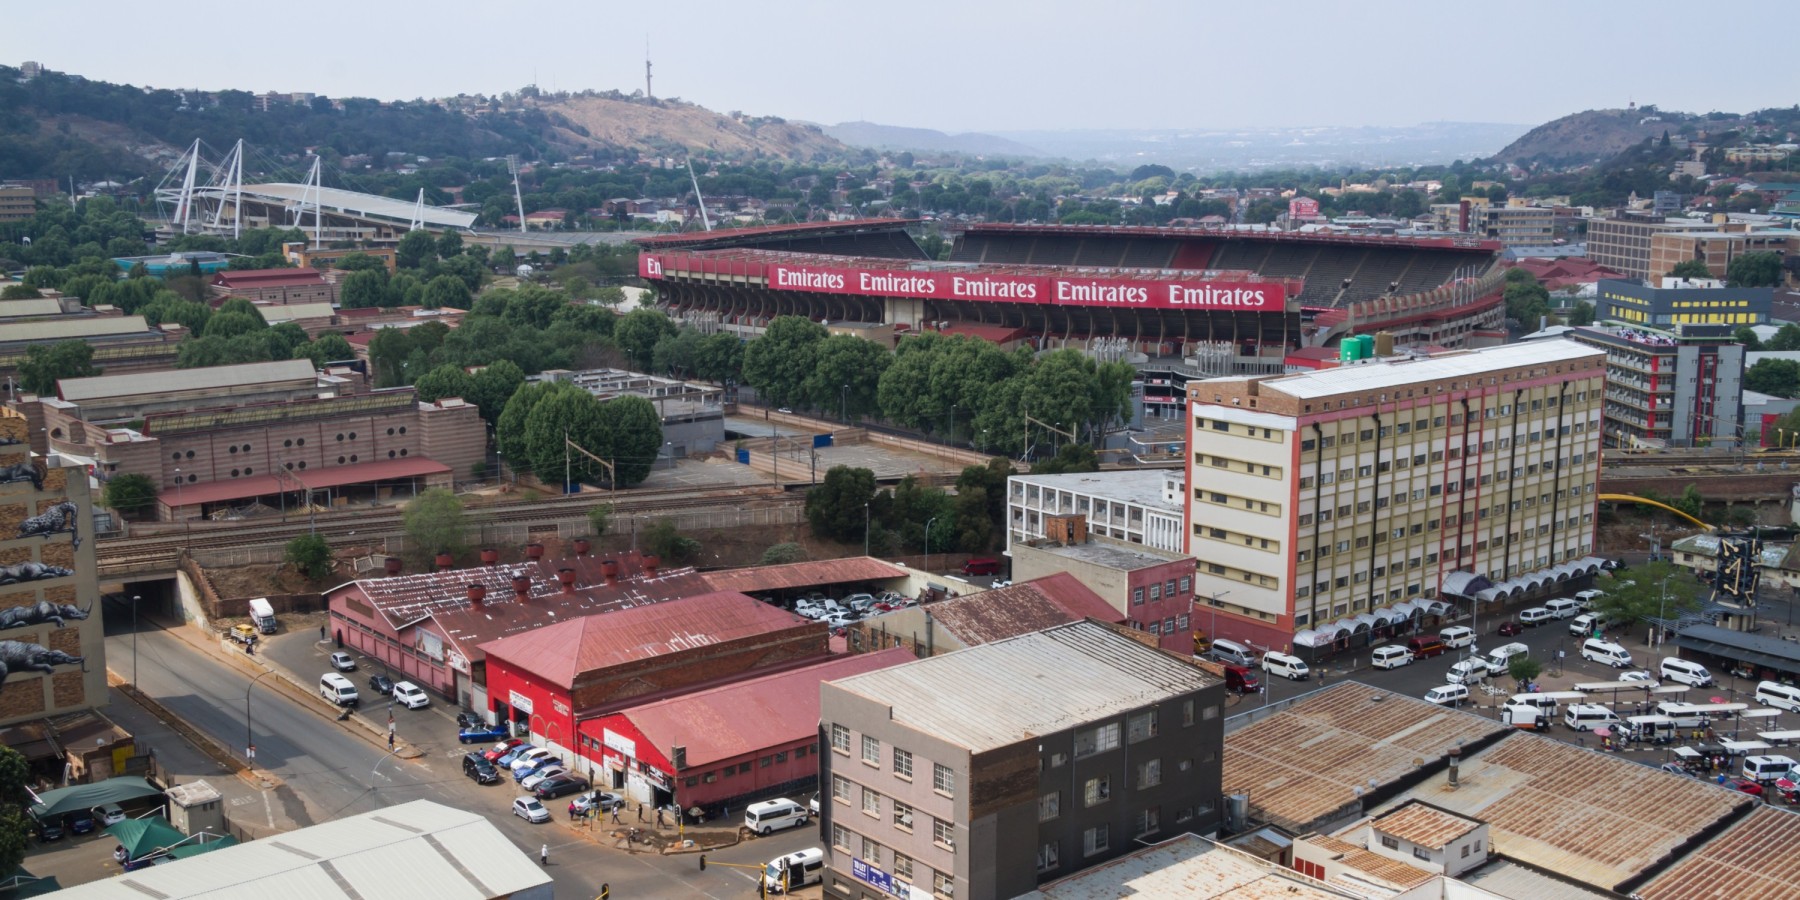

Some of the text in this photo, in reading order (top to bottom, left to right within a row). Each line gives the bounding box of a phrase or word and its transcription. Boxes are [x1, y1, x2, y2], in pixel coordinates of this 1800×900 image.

[778, 268, 844, 289] Emirates
[860, 272, 935, 293] Emirates
[953, 277, 1036, 298] Emirates
[1058, 281, 1147, 302] Emirates
[1169, 285, 1264, 305] Emirates
